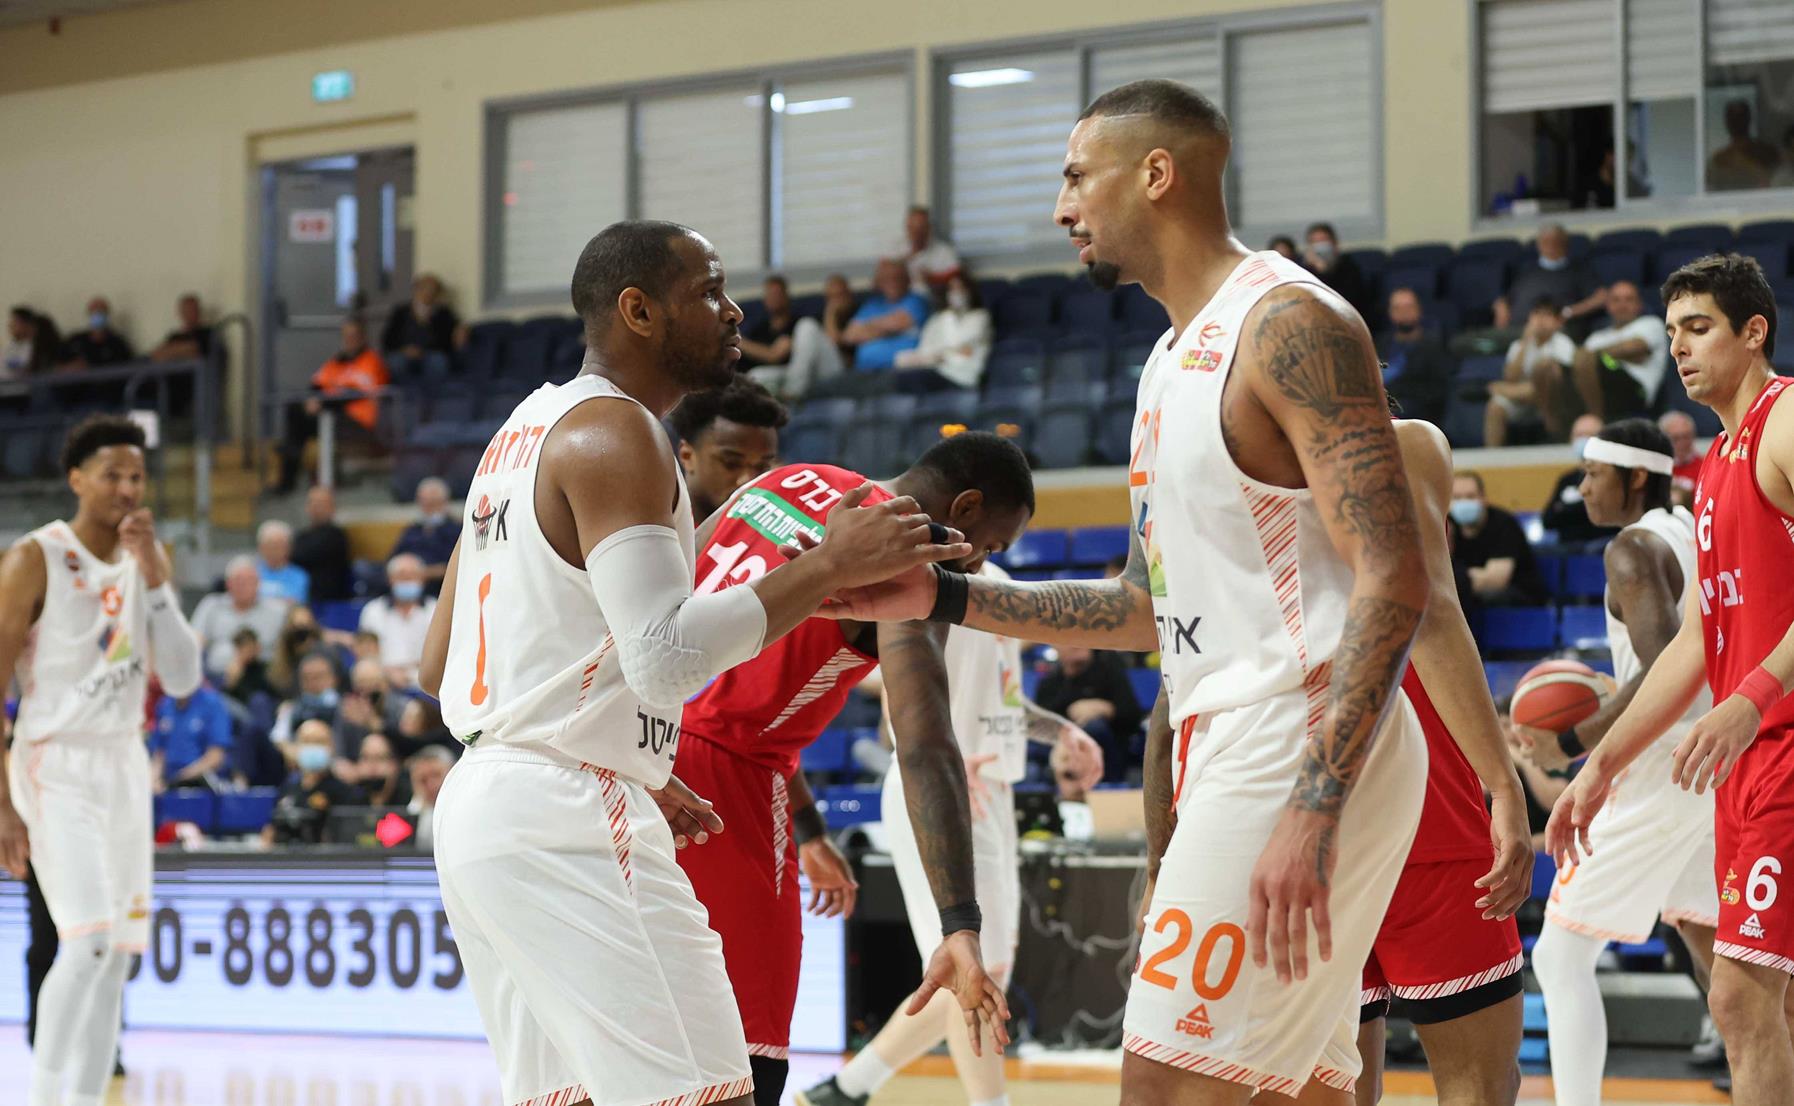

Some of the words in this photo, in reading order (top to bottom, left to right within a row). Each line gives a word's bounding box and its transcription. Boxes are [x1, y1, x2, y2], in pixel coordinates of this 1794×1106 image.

[1130, 409, 1162, 487] 2
[1697, 497, 1713, 552] 6
[637, 705, 678, 761] יטל
[1745, 855, 1782, 912] 6
[127, 906, 464, 991] 0-888305
[1140, 908, 1246, 1001] 20
[1739, 924, 1766, 940] PEAK
[1175, 1018, 1216, 1040] PEAK
